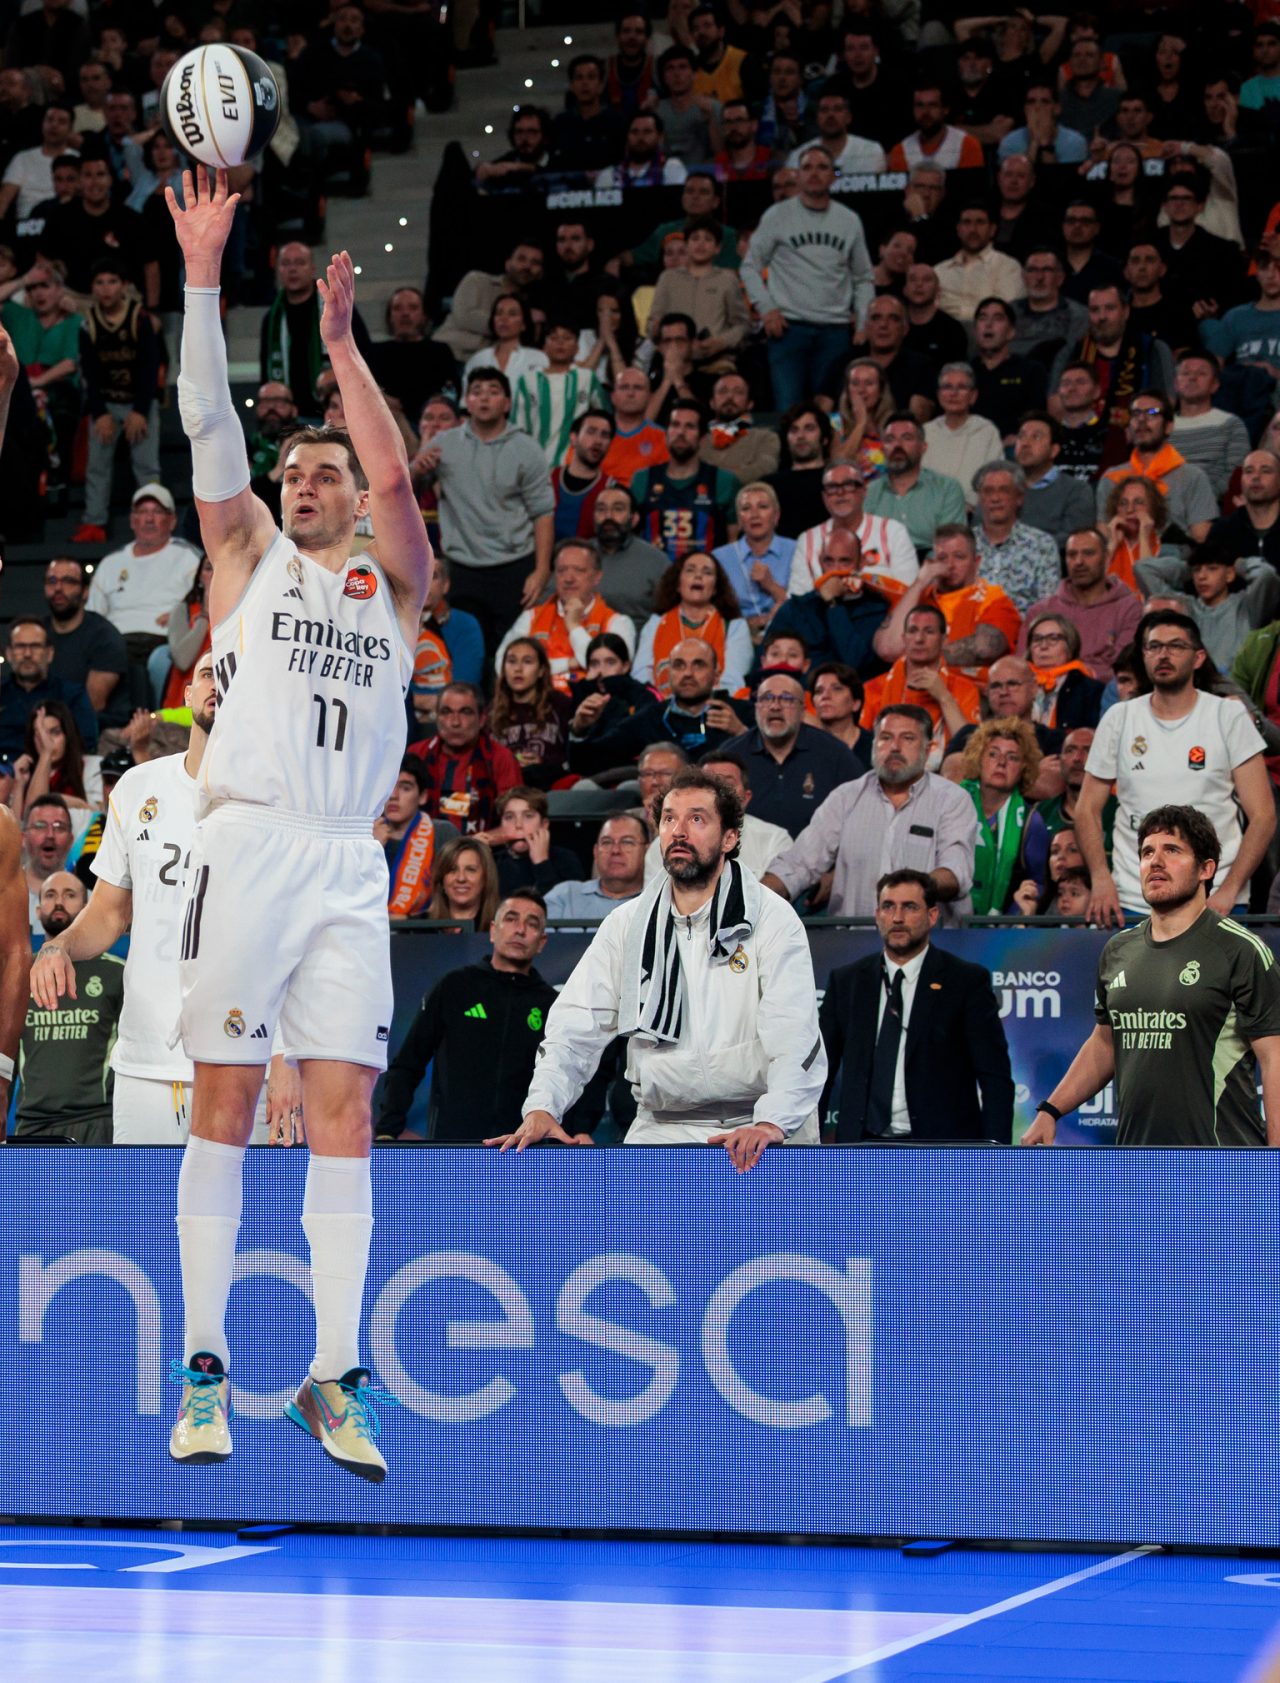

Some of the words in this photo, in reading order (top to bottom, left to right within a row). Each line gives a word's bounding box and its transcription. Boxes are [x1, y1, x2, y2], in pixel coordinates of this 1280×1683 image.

[176, 62, 205, 147] Wilson
[662, 509, 693, 538] 33
[271, 612, 391, 661] Emirates
[288, 648, 318, 675] FLY
[313, 693, 348, 752] 11
[159, 842, 191, 887] 2
[991, 970, 1061, 987] BANCO
[25, 1007, 100, 1027] Emirates
[1110, 1007, 1187, 1030] Emirates
[34, 1025, 51, 1041] FLY
[52, 1024, 89, 1041] BETTER
[1122, 1032, 1136, 1050] FLY
[1137, 1031, 1172, 1050] BETTER
